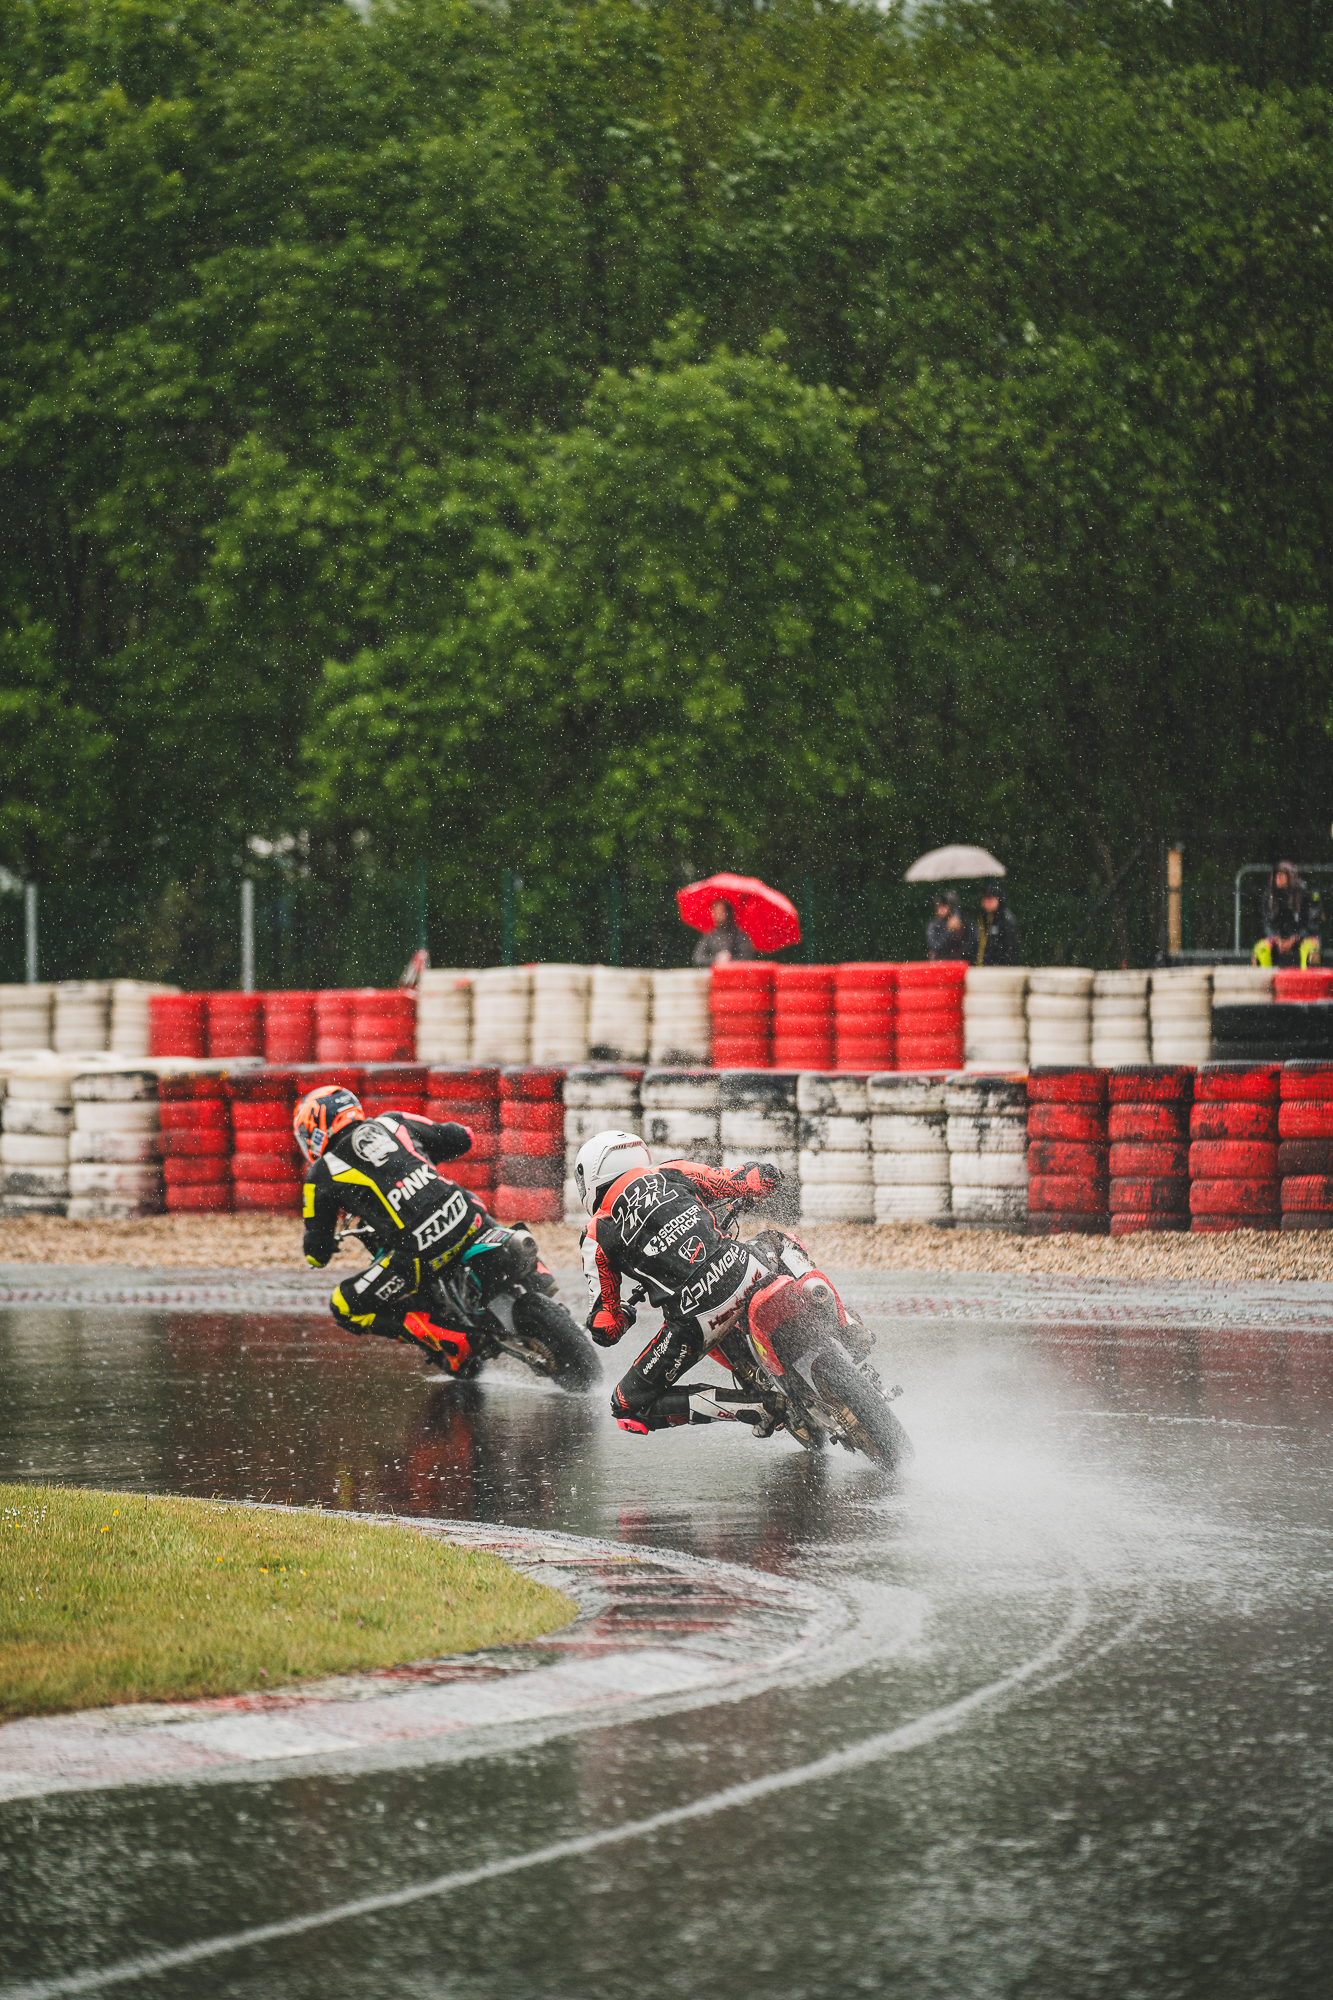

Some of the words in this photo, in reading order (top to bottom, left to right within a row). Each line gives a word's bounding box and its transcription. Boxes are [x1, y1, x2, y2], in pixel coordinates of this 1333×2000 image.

[412, 1190, 468, 1251] RMD
[611, 1173, 679, 1246] 222
[659, 1204, 701, 1238] SCOOTER
[665, 1214, 701, 1246] ATTACK
